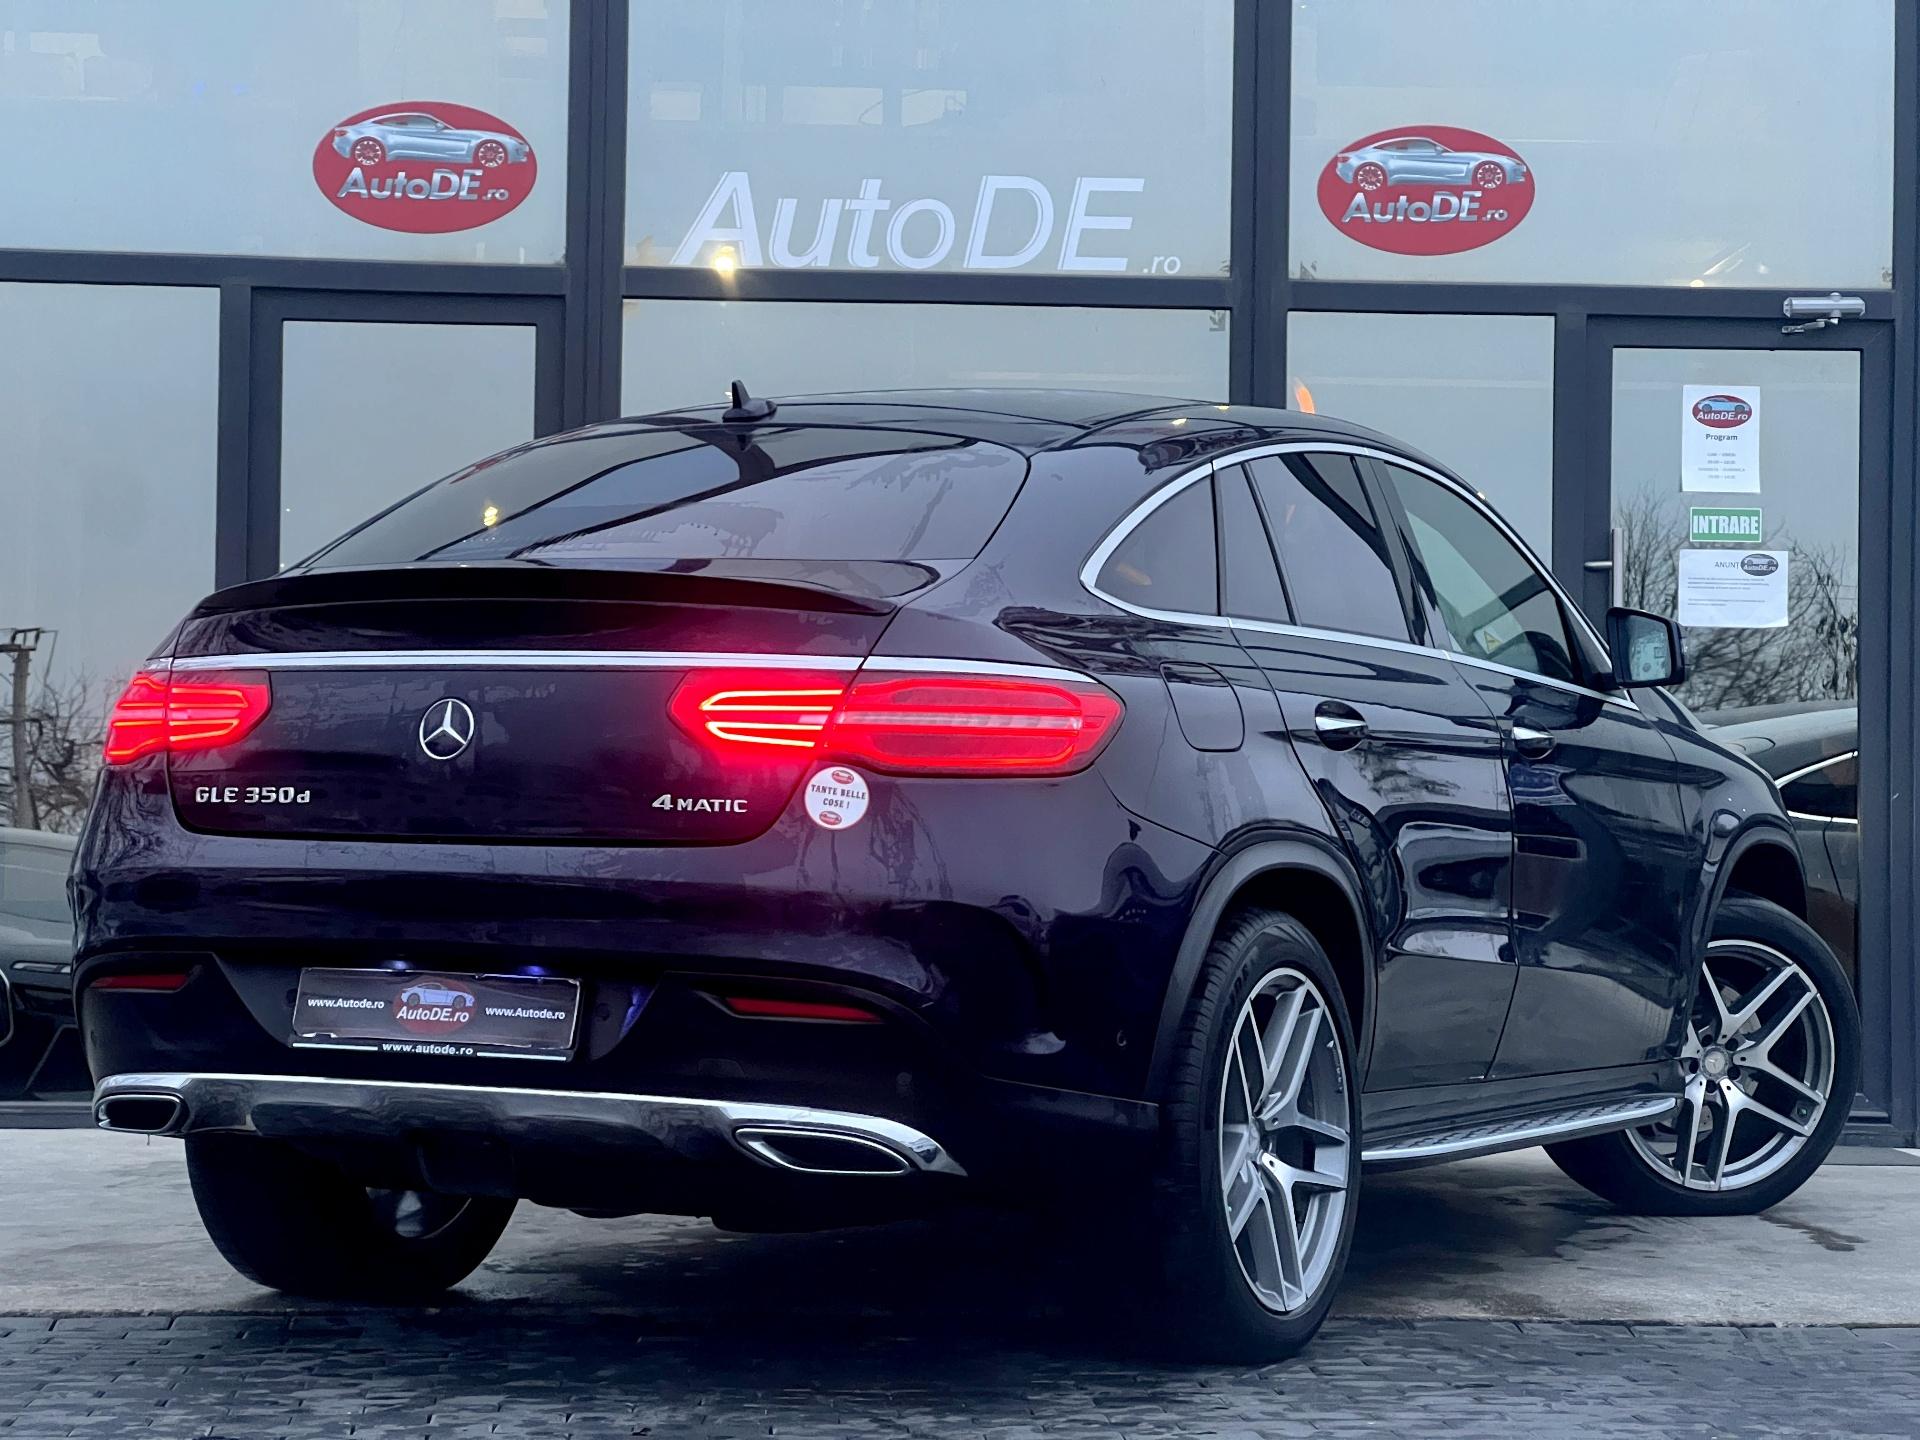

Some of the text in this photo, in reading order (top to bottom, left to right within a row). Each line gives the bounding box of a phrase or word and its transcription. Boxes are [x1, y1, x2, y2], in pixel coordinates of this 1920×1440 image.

[1697, 411, 1748, 421] AutoDE.ro
[1705, 433, 1738, 442] Program
[1693, 514, 1758, 534] INTRARE
[195, 786, 311, 804] GLE 350d
[811, 784, 866, 800] TANTE BELLE
[307, 998, 566, 1023] www.Autode.ro AutoDE.ro www.Autode.ro
[382, 1043, 474, 1056] www.autode.ro
